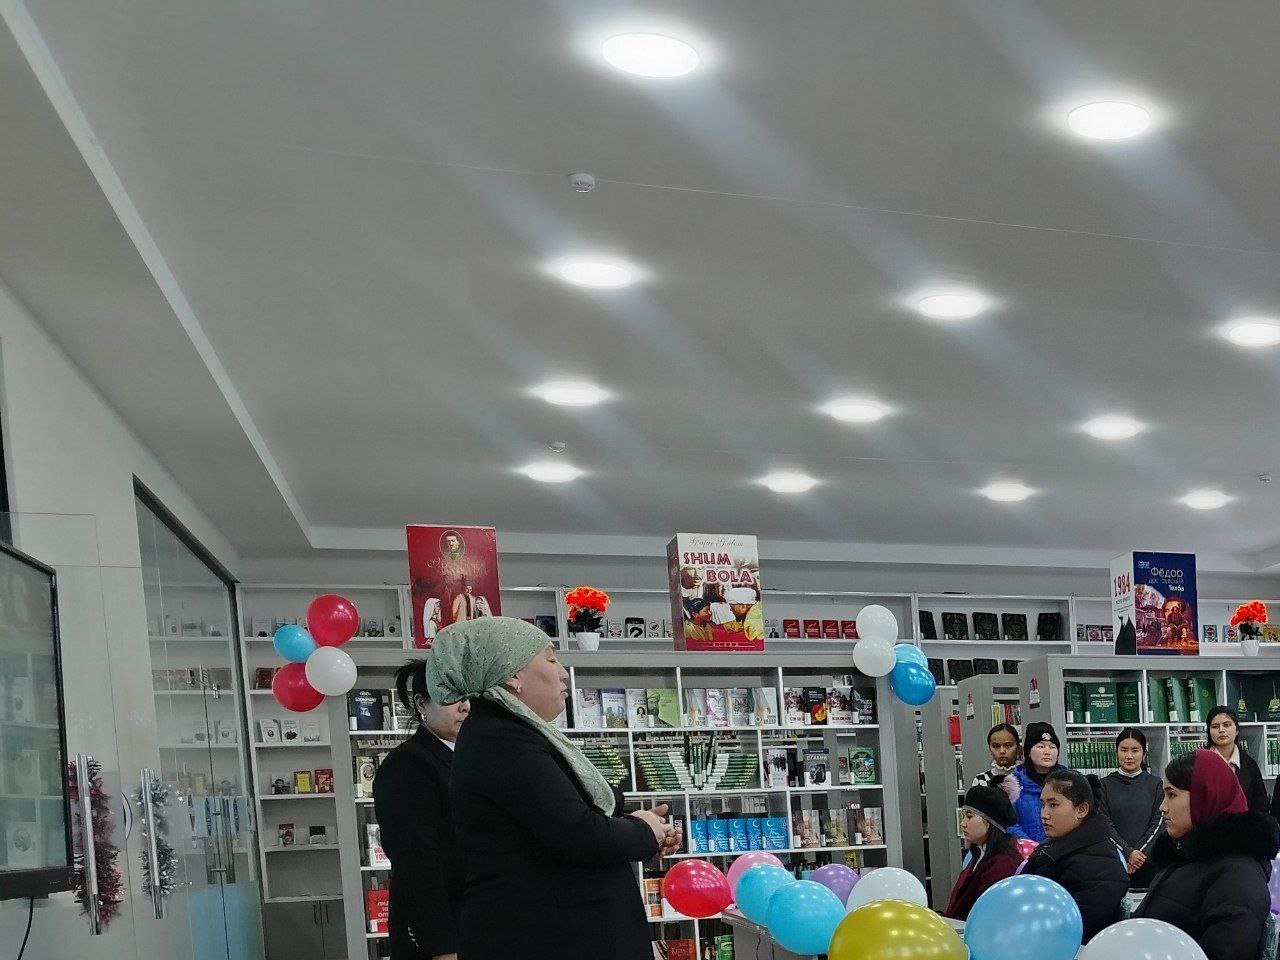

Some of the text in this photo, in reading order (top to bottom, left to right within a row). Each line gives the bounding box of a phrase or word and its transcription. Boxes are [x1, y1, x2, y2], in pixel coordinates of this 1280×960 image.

[683, 552, 731, 565] SHUM
[706, 570, 752, 583] BOLA
[1151, 566, 1184, 578] Фёдор
[1113, 571, 1131, 597] 1984
